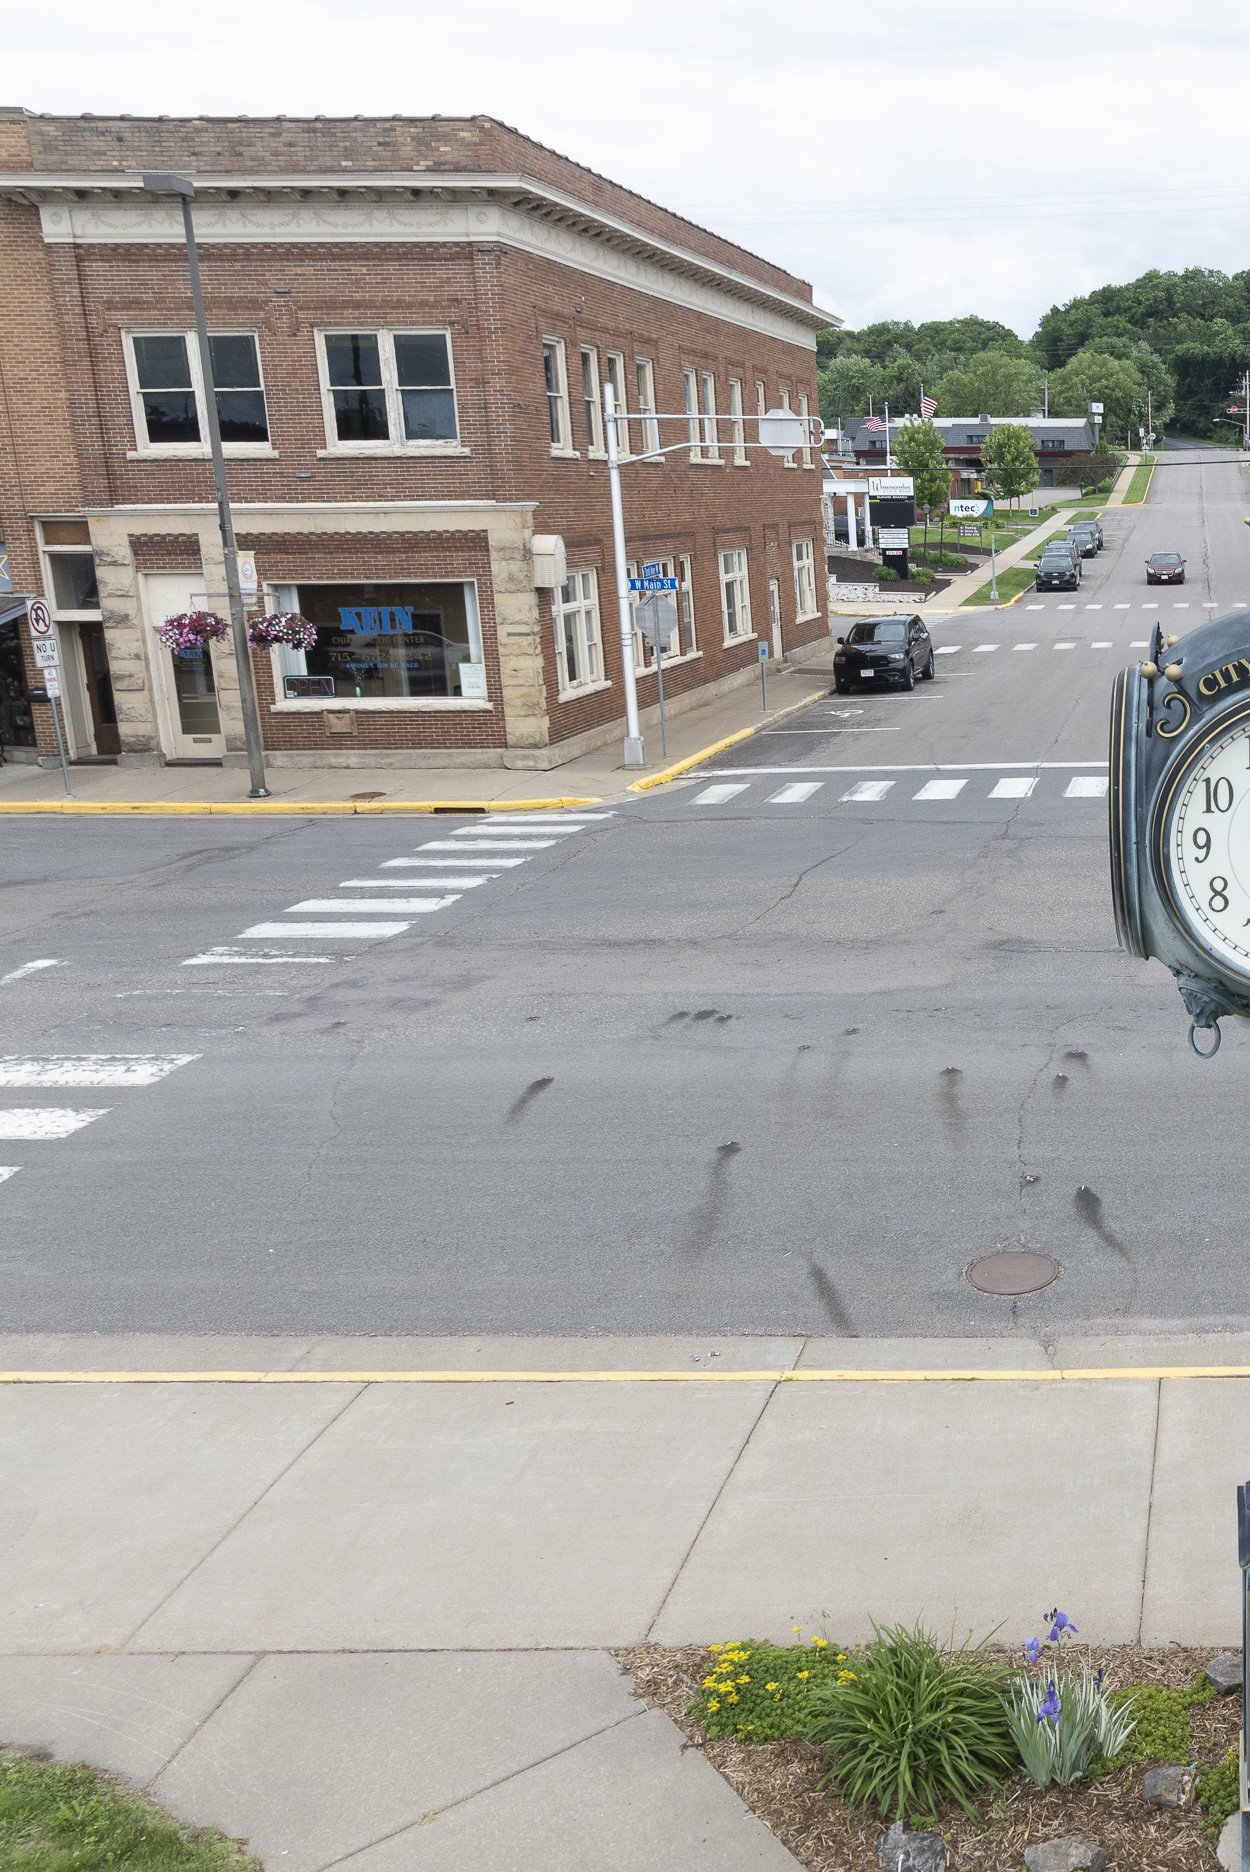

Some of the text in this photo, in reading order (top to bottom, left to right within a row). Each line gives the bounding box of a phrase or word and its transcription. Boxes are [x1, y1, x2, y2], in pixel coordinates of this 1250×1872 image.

[954, 503, 976, 512] ntec
[635, 579, 671, 589] W Main St
[338, 607, 413, 634] KEIN
[36, 643, 55, 653] NO U
[1202, 777, 1234, 814] 10
[1193, 827, 1212, 863] 9
[1209, 876, 1229, 912] 8
